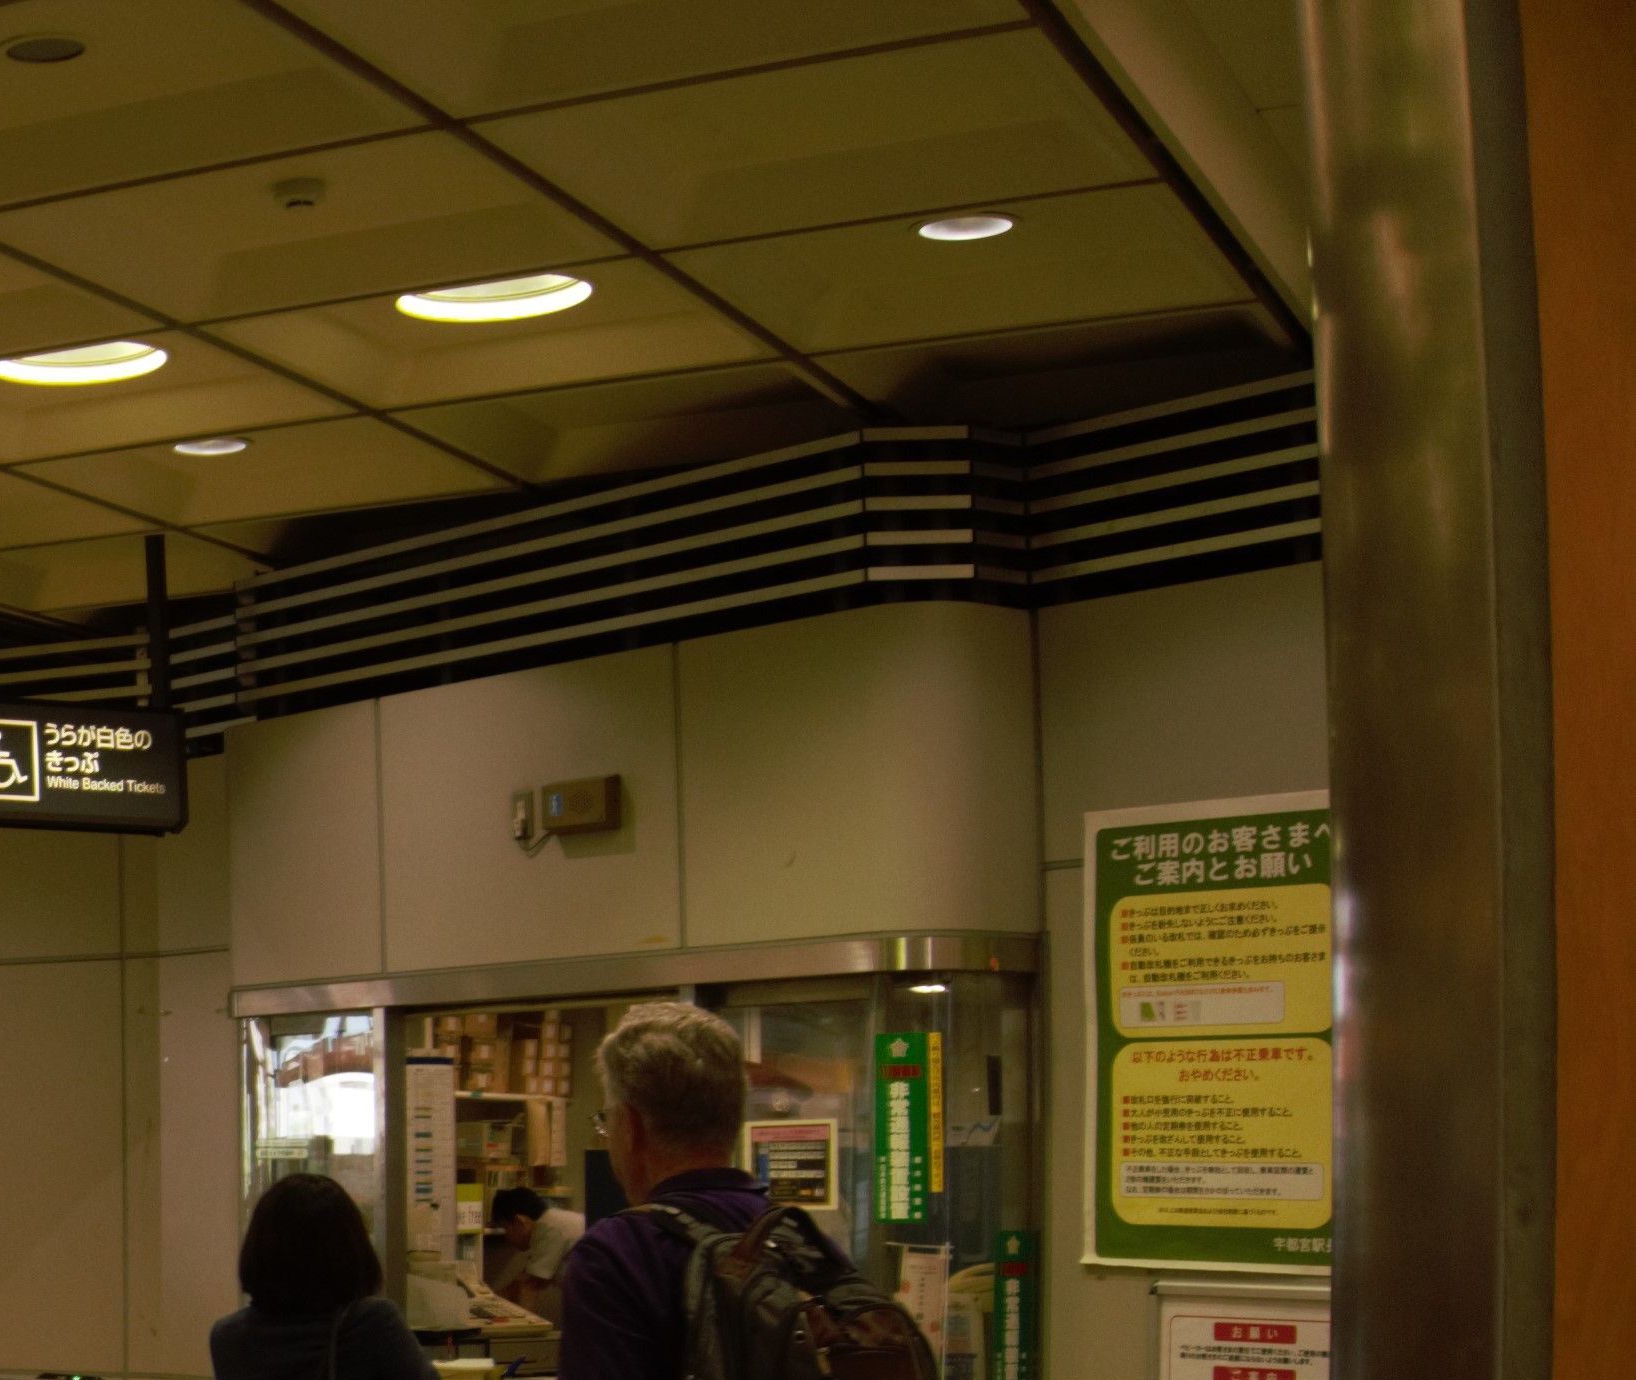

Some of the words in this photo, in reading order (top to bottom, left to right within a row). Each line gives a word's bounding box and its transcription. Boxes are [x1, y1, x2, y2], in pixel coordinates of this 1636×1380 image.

[44, 722, 152, 750] うらが白色の
[45, 749, 99, 774] きっぷ
[46, 776, 79, 790] White
[82, 777, 123, 792] Backed
[126, 780, 166, 795] Tickets
[1133, 851, 1312, 886] ご案内とお願い
[1178, 1068, 1260, 1083] おやめください。
